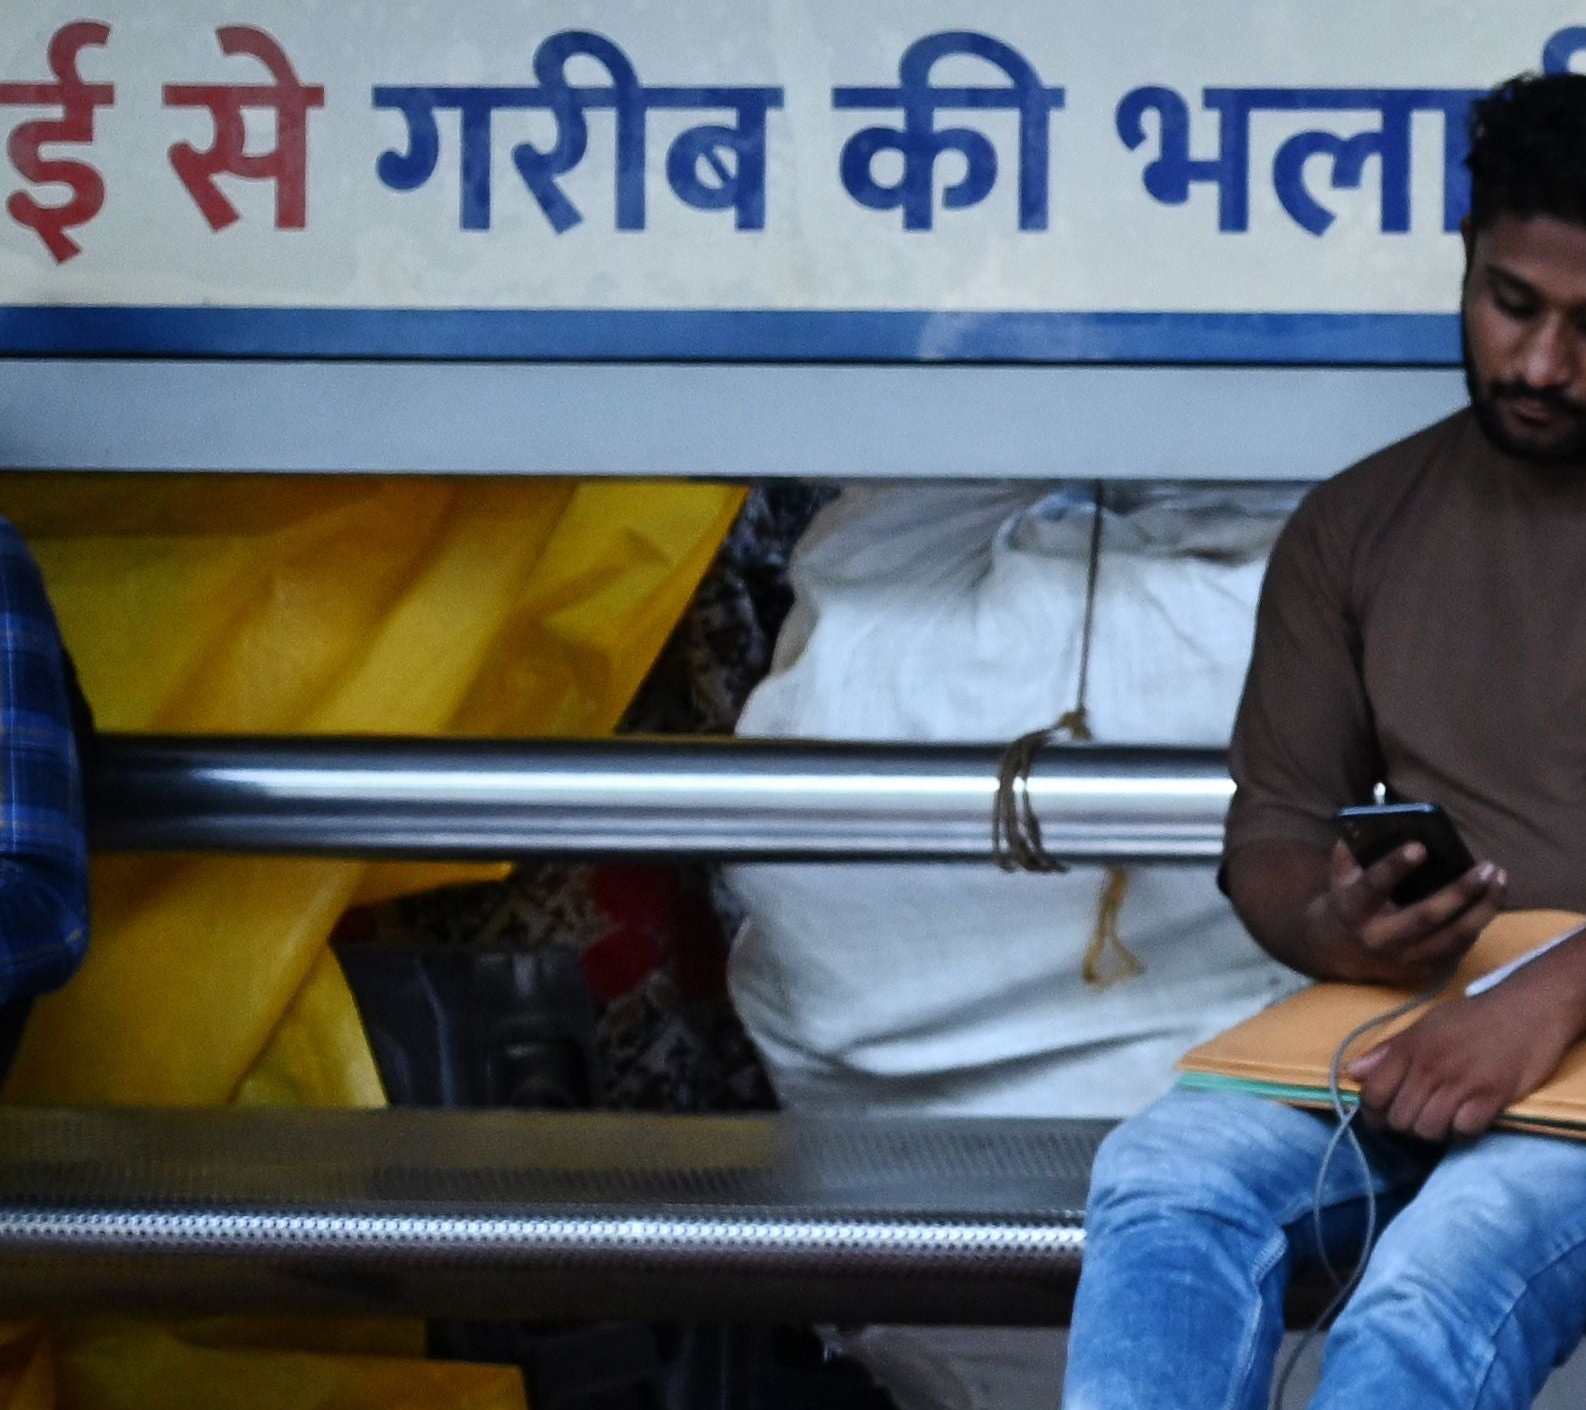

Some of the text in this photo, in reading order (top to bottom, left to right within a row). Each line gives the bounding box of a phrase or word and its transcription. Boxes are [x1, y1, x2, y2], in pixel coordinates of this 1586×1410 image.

[162, 23, 326, 234] से
[371, 29, 785, 236] गरीब
[830, 29, 1066, 234] की
